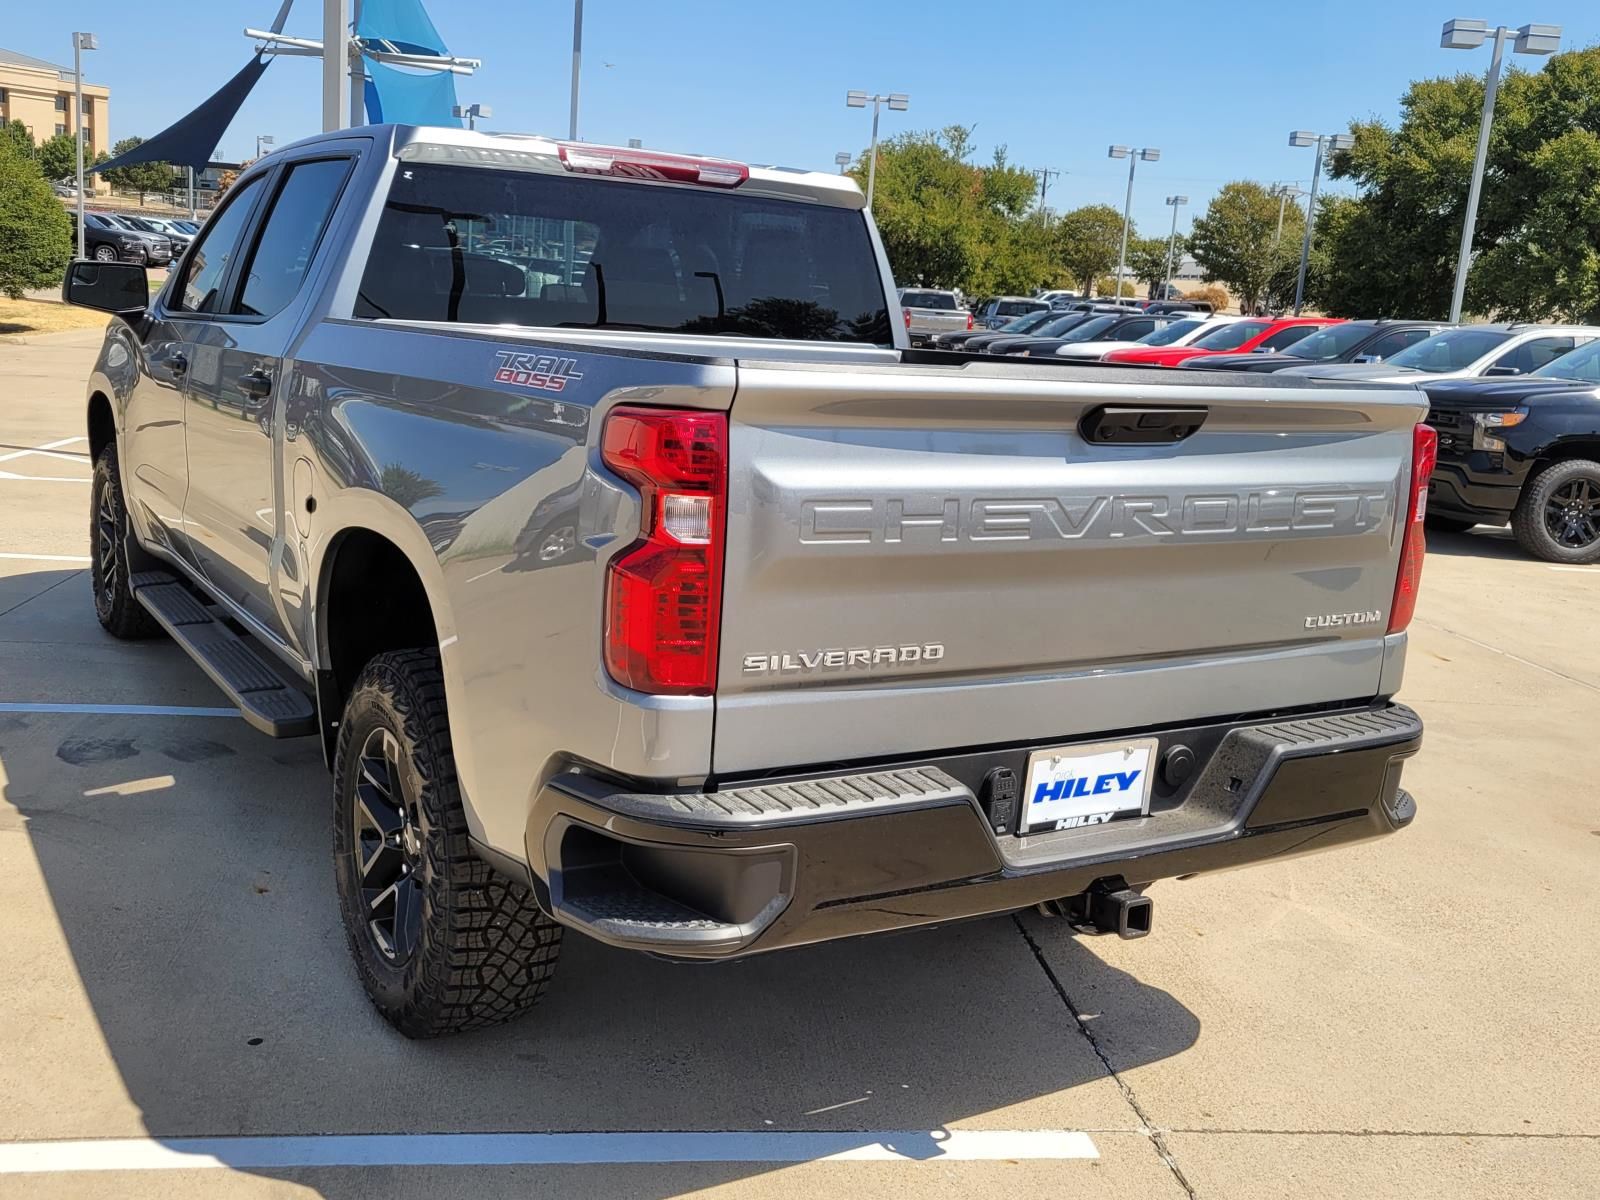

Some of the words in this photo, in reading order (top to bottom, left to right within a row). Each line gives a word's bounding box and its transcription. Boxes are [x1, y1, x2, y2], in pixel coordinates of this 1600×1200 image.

[493, 368, 567, 392] BOSS
[496, 350, 584, 380] TRAIL
[799, 489, 1386, 545] CHEVROLET
[1304, 610, 1381, 628] CUSTOM
[743, 643, 945, 673] SILVERADO
[1033, 769, 1142, 804] HILEY
[1055, 811, 1115, 831] HILEY
